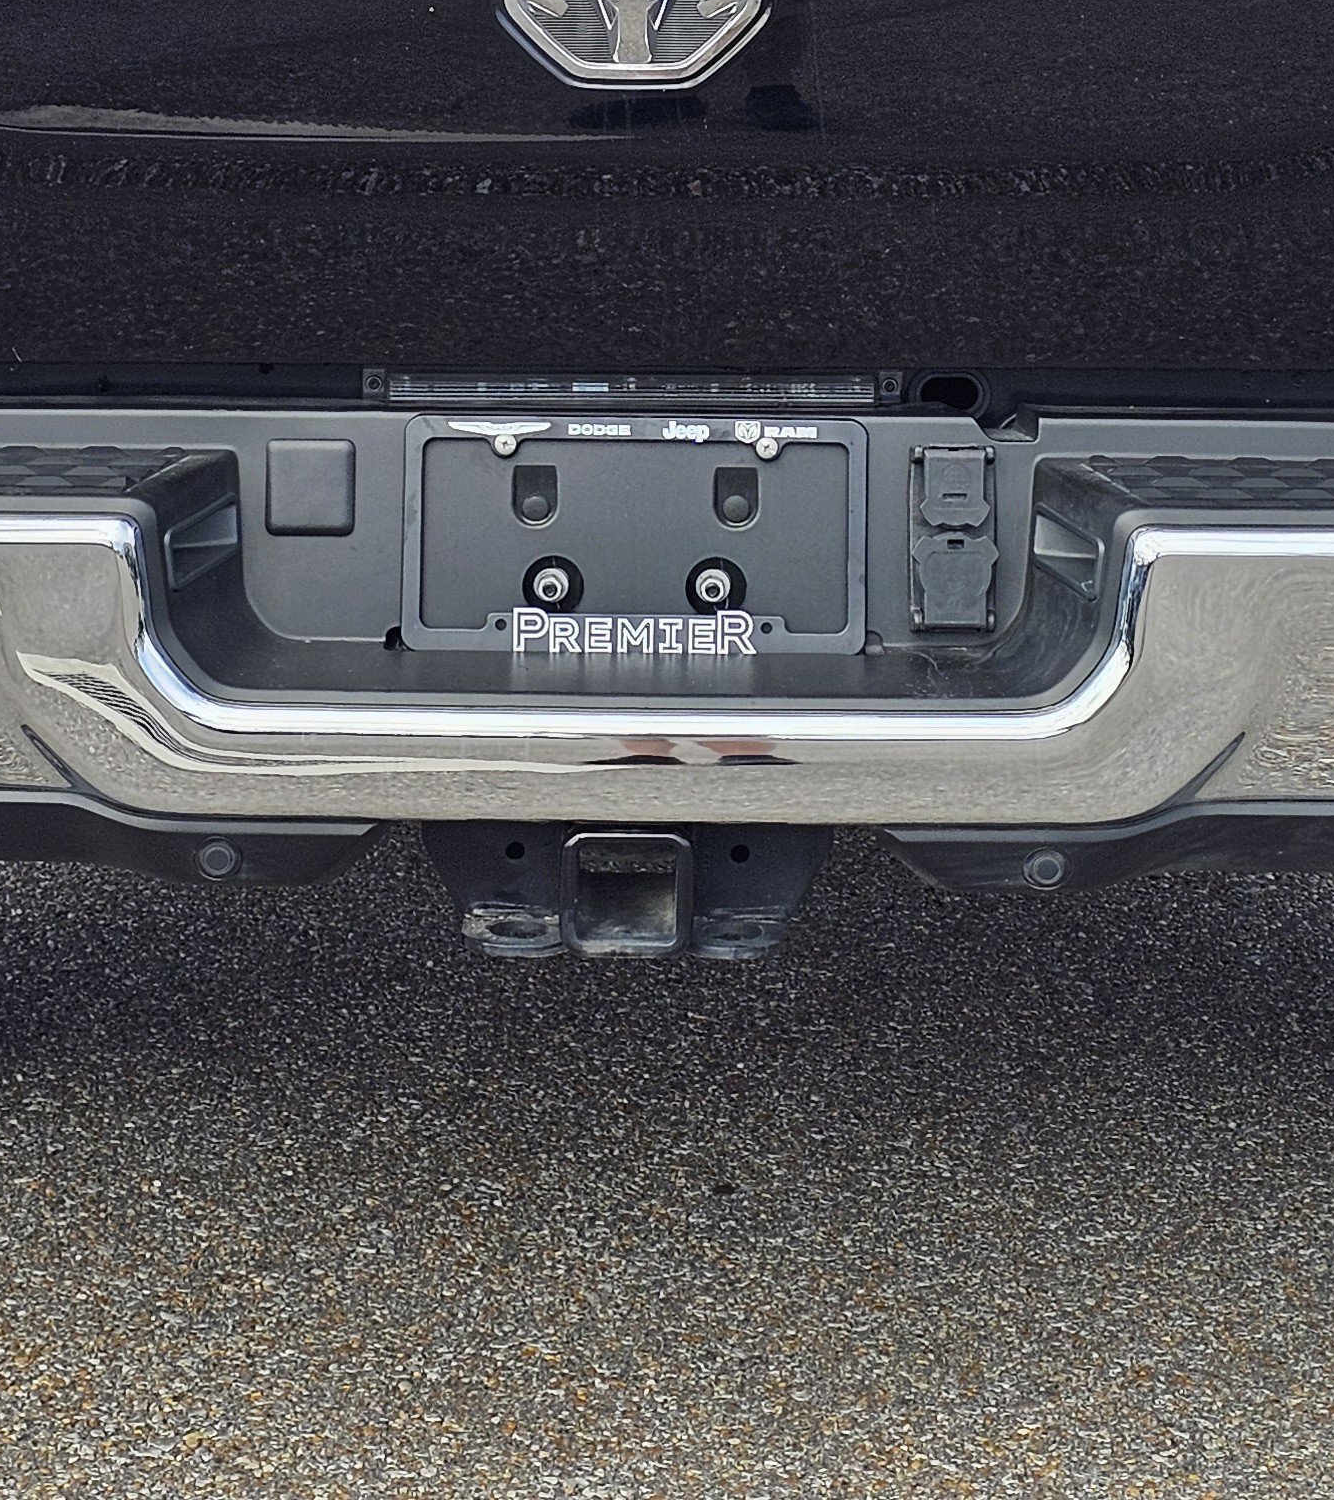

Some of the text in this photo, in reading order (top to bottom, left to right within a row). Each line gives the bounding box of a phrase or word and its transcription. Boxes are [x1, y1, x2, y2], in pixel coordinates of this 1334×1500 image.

[567, 420, 818, 443] DODGE Jeep RAM
[512, 606, 758, 655] PREMIER
